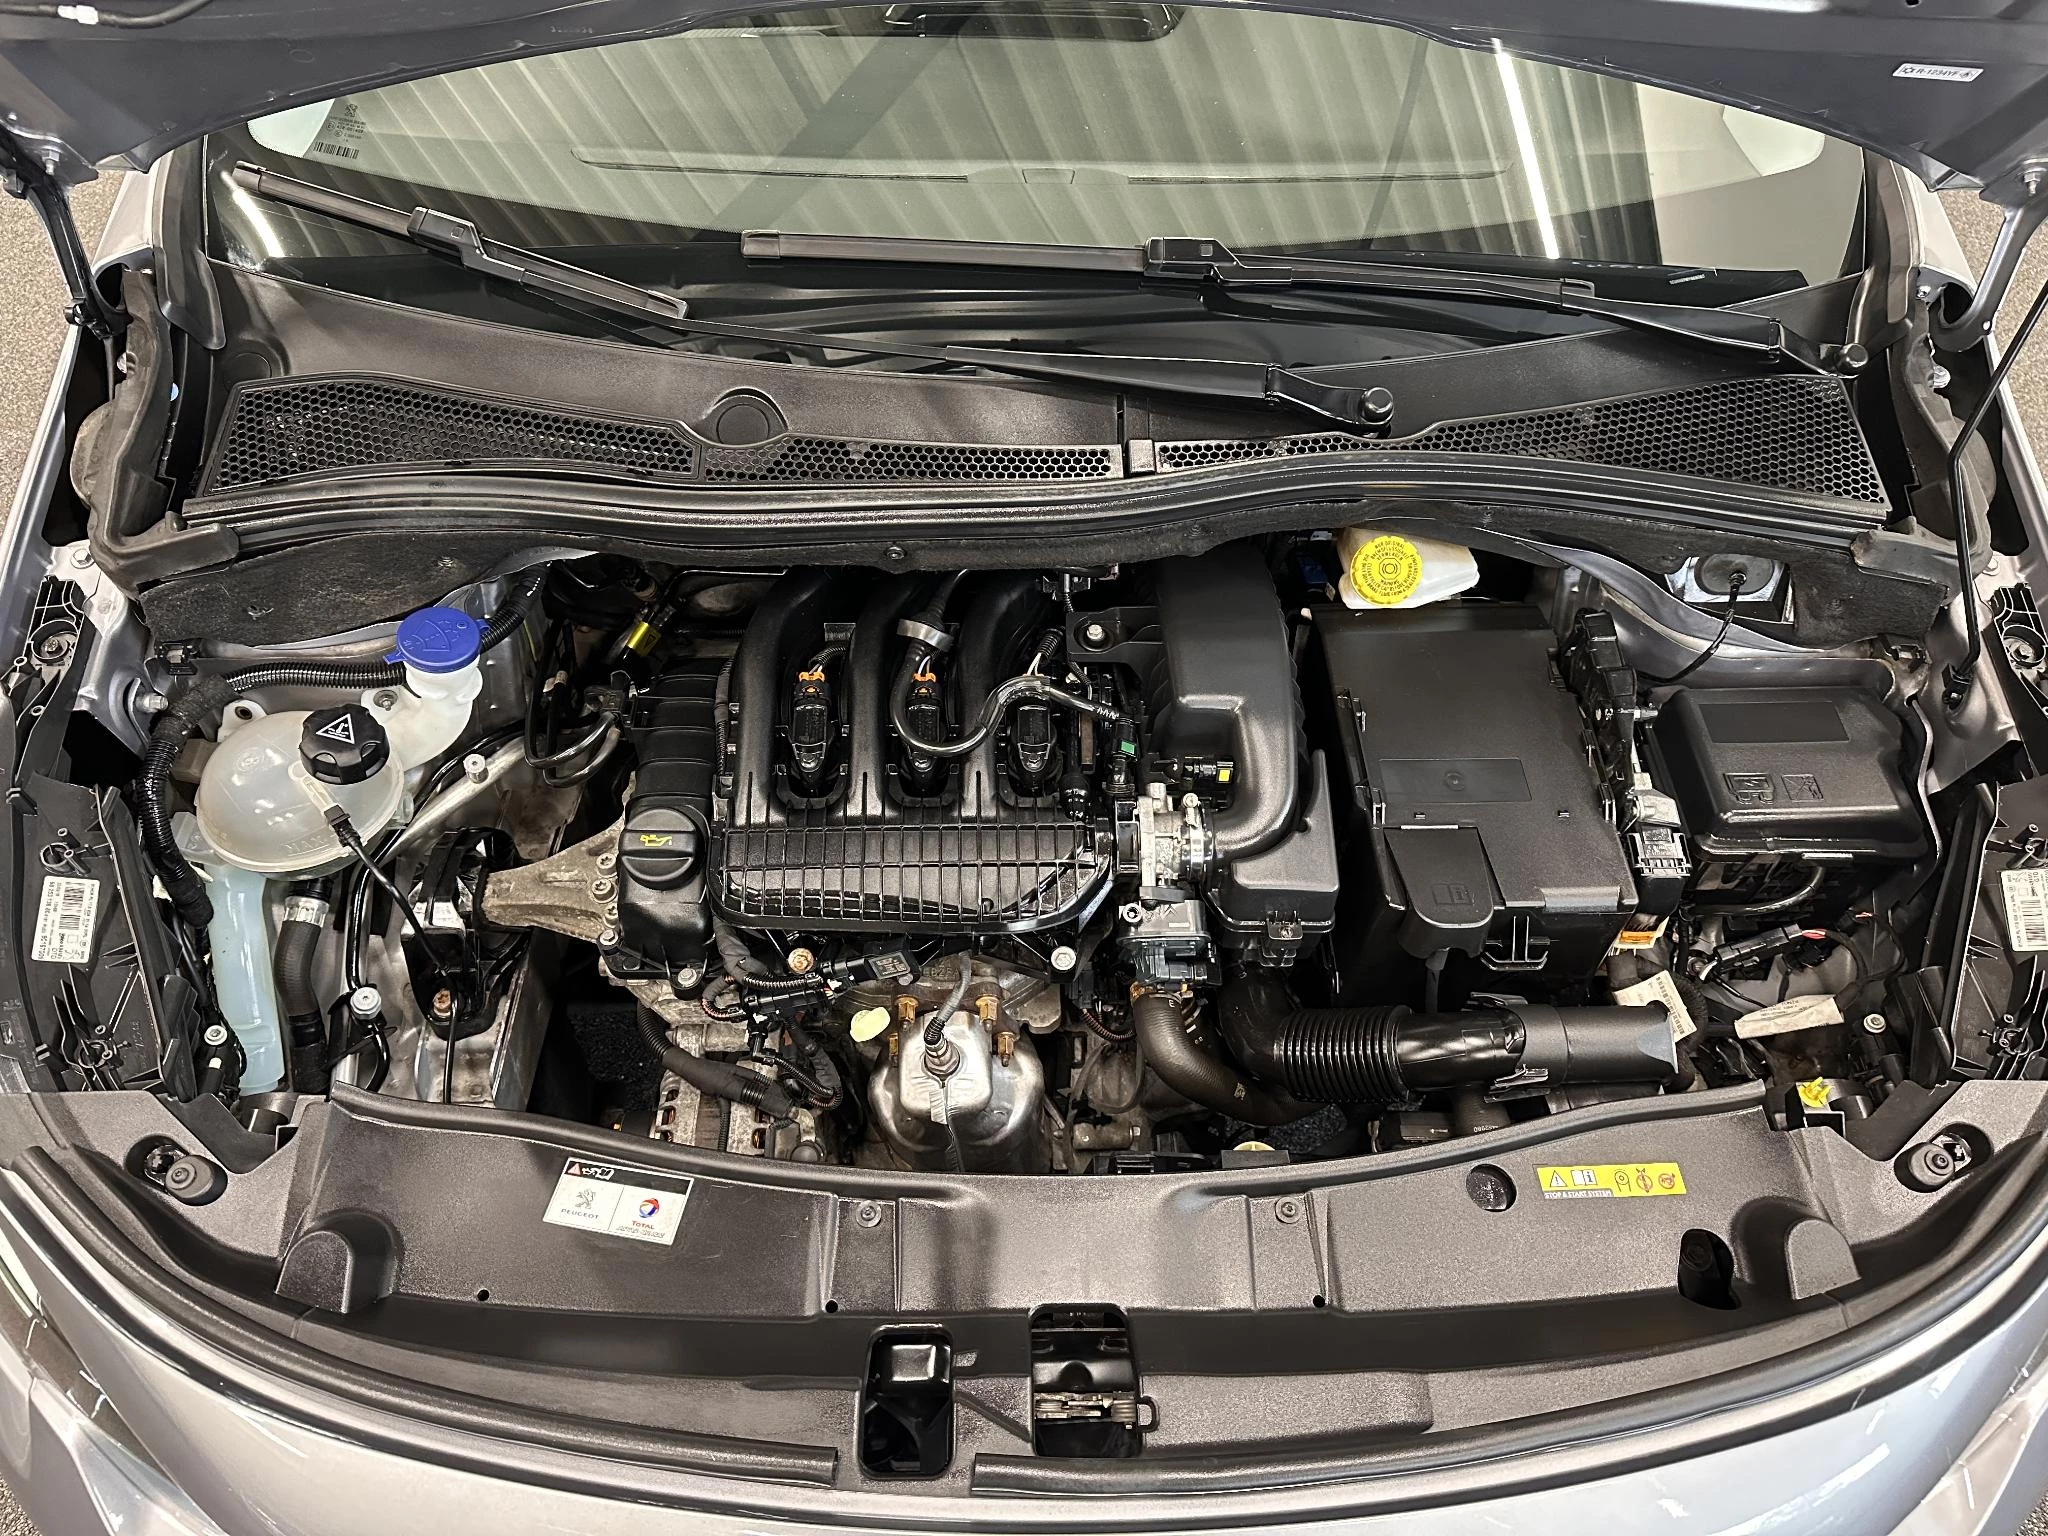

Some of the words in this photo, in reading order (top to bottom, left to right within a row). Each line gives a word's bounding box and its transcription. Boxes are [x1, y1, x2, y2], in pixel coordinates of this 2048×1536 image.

[1916, 67, 1958, 77] R-1234YF
[1544, 1191, 1561, 1199] STOP
[1568, 1190, 1588, 1198] START
[560, 1208, 600, 1220] PEUGEOT
[632, 1220, 655, 1230] TOTAL
